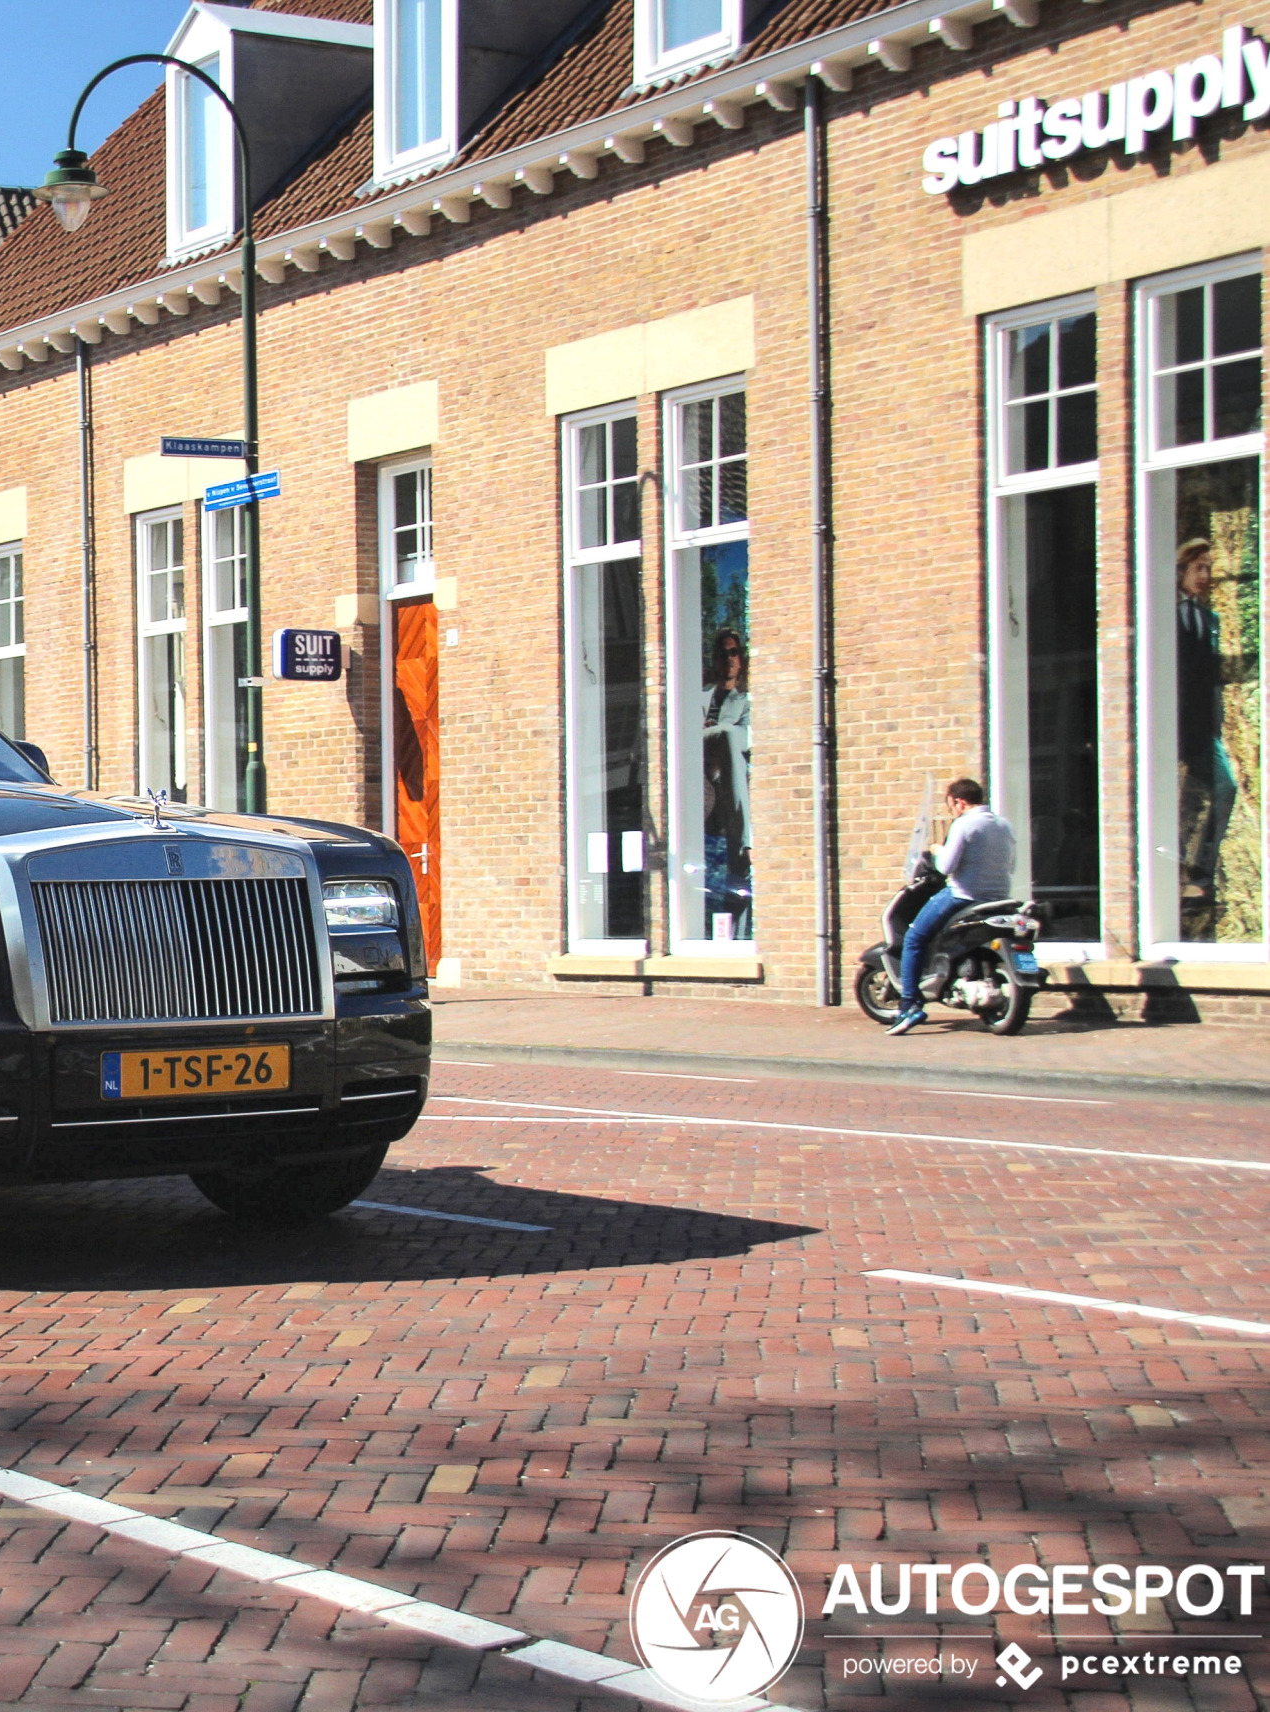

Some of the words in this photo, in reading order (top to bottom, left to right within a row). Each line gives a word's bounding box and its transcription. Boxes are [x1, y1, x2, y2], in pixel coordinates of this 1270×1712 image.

[922, 25, 1270, 195] suitsupply
[165, 441, 240, 453] Klaaskampen
[295, 634, 334, 655] SUIT
[295, 664, 334, 676] supply
[140, 1052, 273, 1090] 1-TSF-26
[105, 1081, 118, 1091] NL
